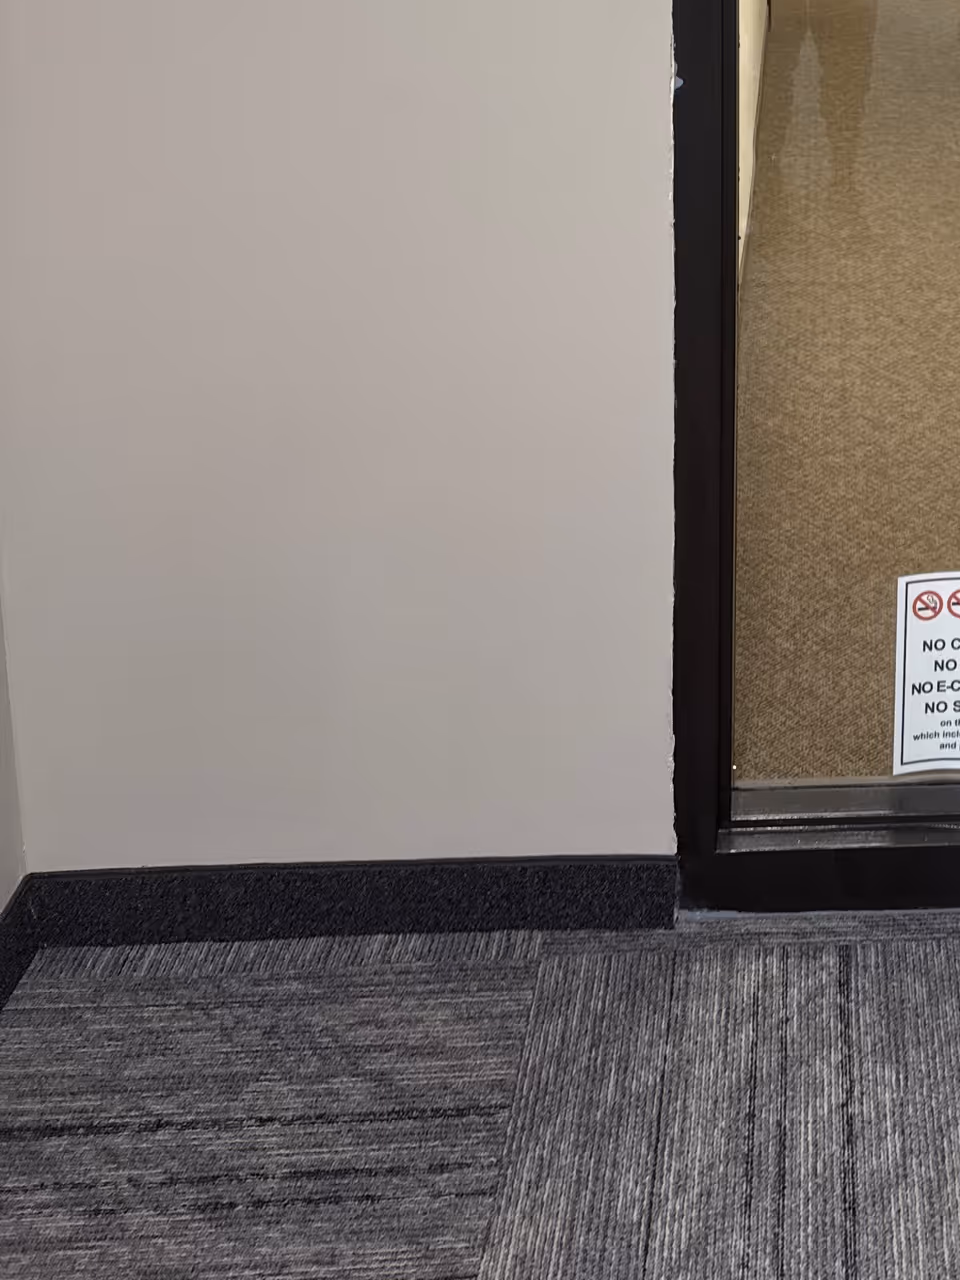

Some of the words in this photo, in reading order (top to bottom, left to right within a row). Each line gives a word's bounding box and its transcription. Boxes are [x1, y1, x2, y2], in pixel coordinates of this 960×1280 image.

[922, 638, 946, 653] NO
[933, 658, 957, 672] NO
[911, 681, 933, 696] NO
[924, 701, 948, 715] NO
[940, 720, 952, 728] on
[912, 730, 940, 741] which
[939, 741, 957, 750] and
